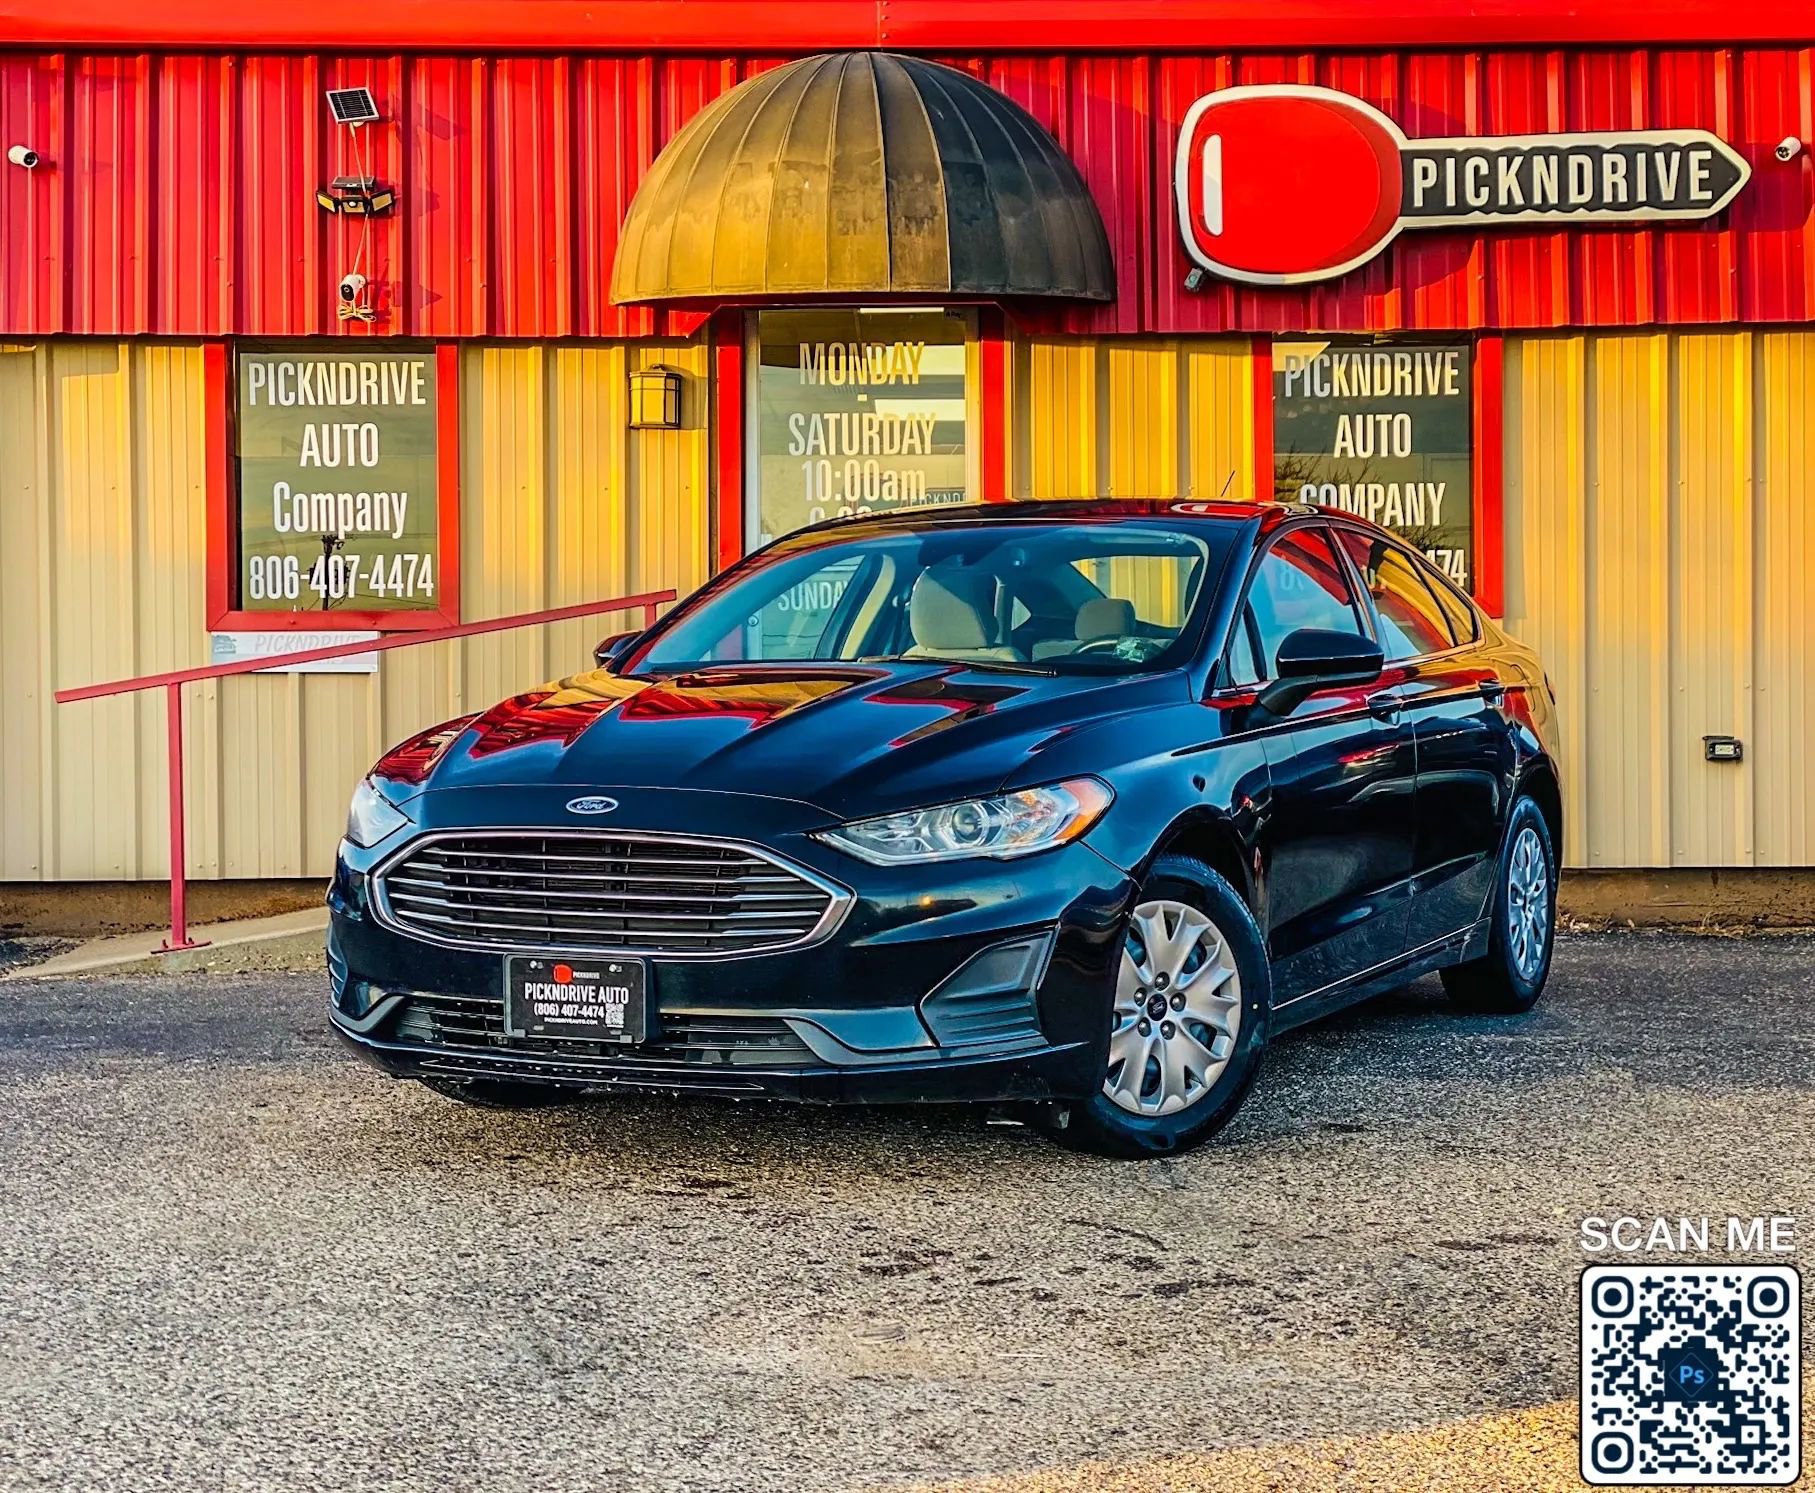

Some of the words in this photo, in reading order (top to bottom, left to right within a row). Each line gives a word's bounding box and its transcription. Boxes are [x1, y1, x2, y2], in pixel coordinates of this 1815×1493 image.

[1413, 149, 1713, 207] PICKNDRIVE
[248, 361, 427, 407] PICKNDRIVE
[800, 341, 925, 386] MONDAY
[1284, 352, 1459, 398] PICKNDRIVE
[300, 422, 379, 468] AUTO
[788, 412, 936, 457] SATURDAY
[1333, 413, 1412, 459] AUTO
[801, 459, 926, 502] 10:00am
[273, 481, 408, 540] Company
[249, 554, 434, 600] 806-407-4474
[525, 983, 595, 1002] PICKNDRIVE
[598, 987, 628, 1003] AUTO
[534, 1003, 558, 1016] (806)
[562, 1005, 604, 1017] 407-4474
